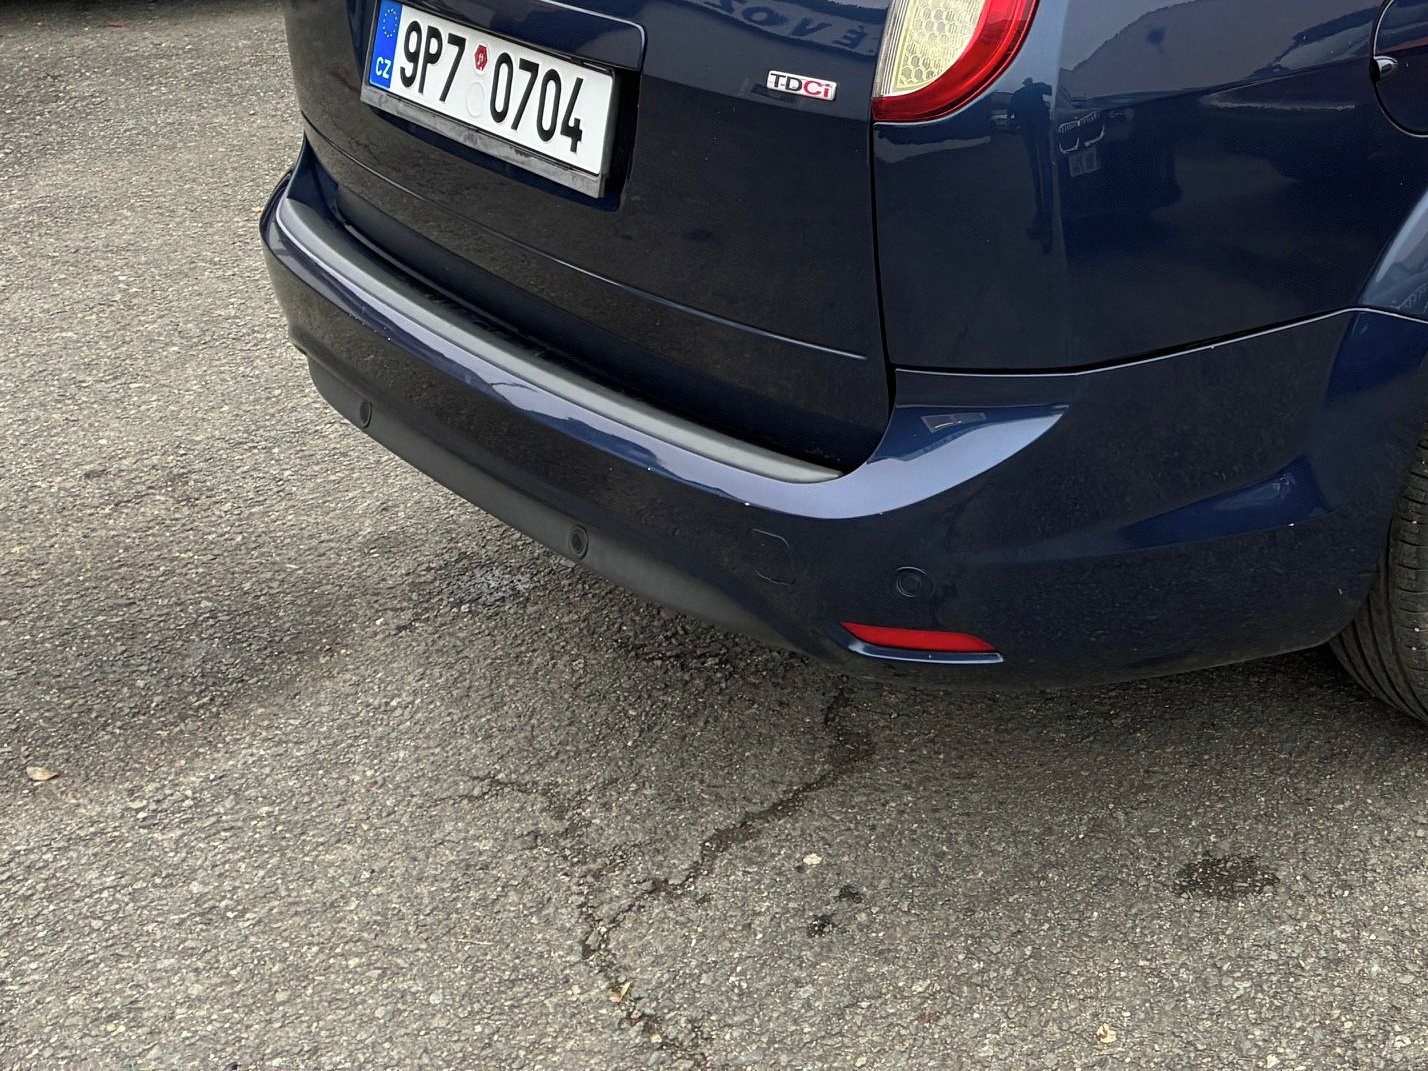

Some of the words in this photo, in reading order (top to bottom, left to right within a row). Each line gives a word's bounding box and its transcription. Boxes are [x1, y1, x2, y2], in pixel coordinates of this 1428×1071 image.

[375, 56, 392, 79] CZ
[399, 20, 467, 103] 9P7
[489, 51, 585, 154] 0704
[770, 73, 833, 98] TDCi
